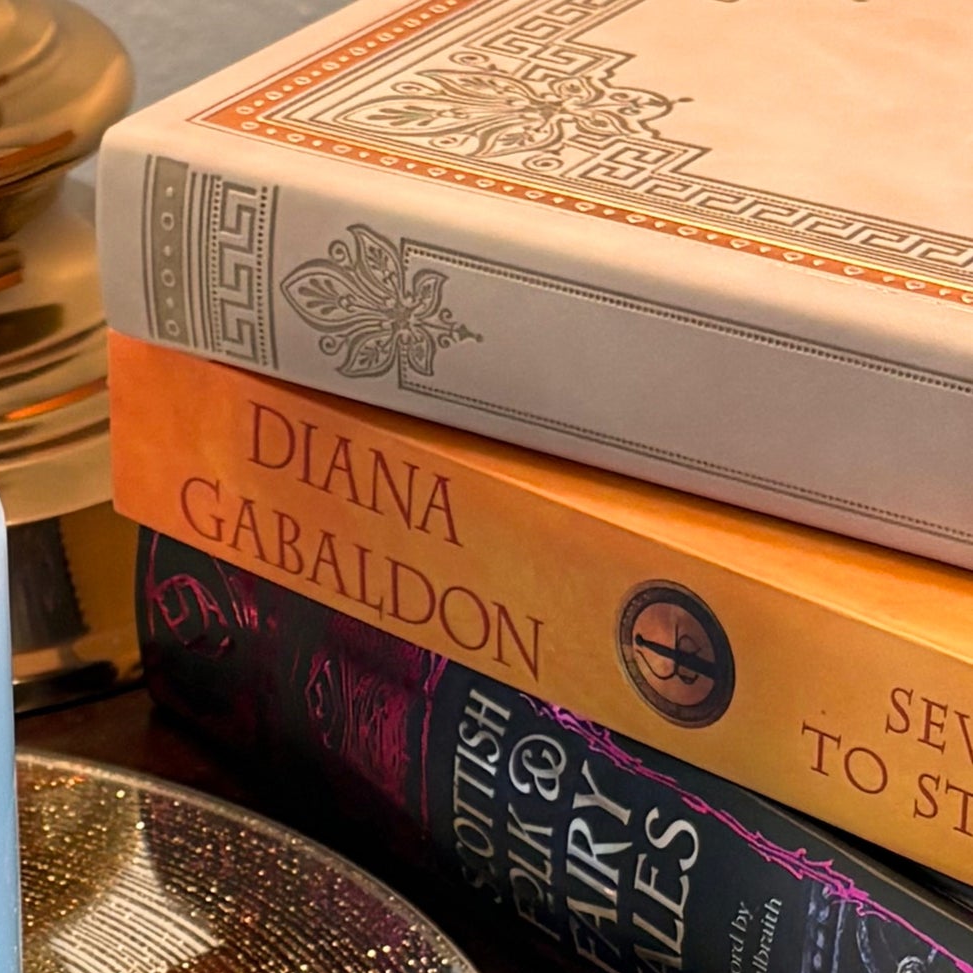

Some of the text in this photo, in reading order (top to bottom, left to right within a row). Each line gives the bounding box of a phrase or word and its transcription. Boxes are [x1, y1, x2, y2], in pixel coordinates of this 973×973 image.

[247, 400, 464, 547] DIANA
[180, 476, 544, 683] GABALDON
[507, 734, 567, 942] FOLK &
[801, 720, 973, 838] TO ST
[731, 900, 753, 933] by
